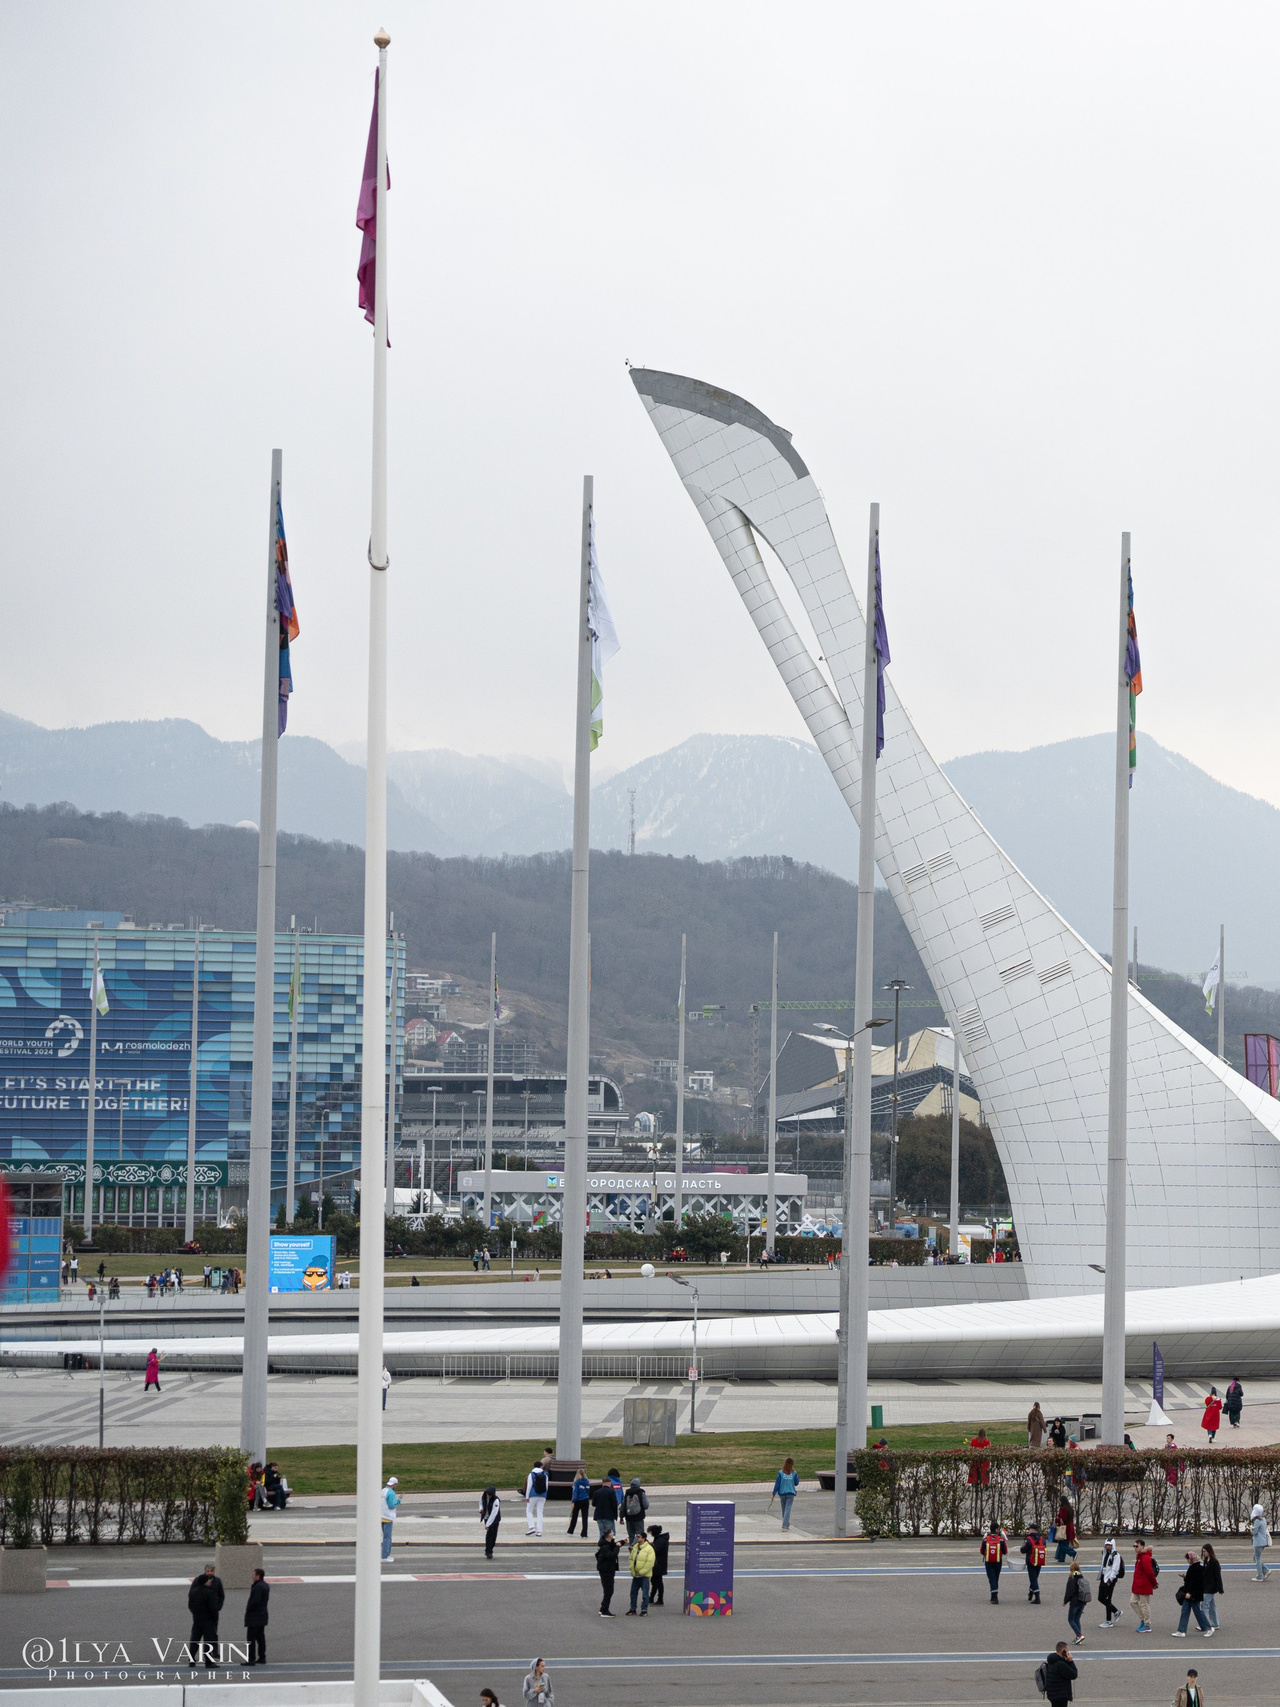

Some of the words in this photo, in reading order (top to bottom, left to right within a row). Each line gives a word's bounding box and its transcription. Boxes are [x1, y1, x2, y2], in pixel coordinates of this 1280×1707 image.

[126, 1040, 191, 1050] rosmolodezh
[55, 1077, 114, 1091] START
[77, 1097, 188, 1111] TOGETHER!
